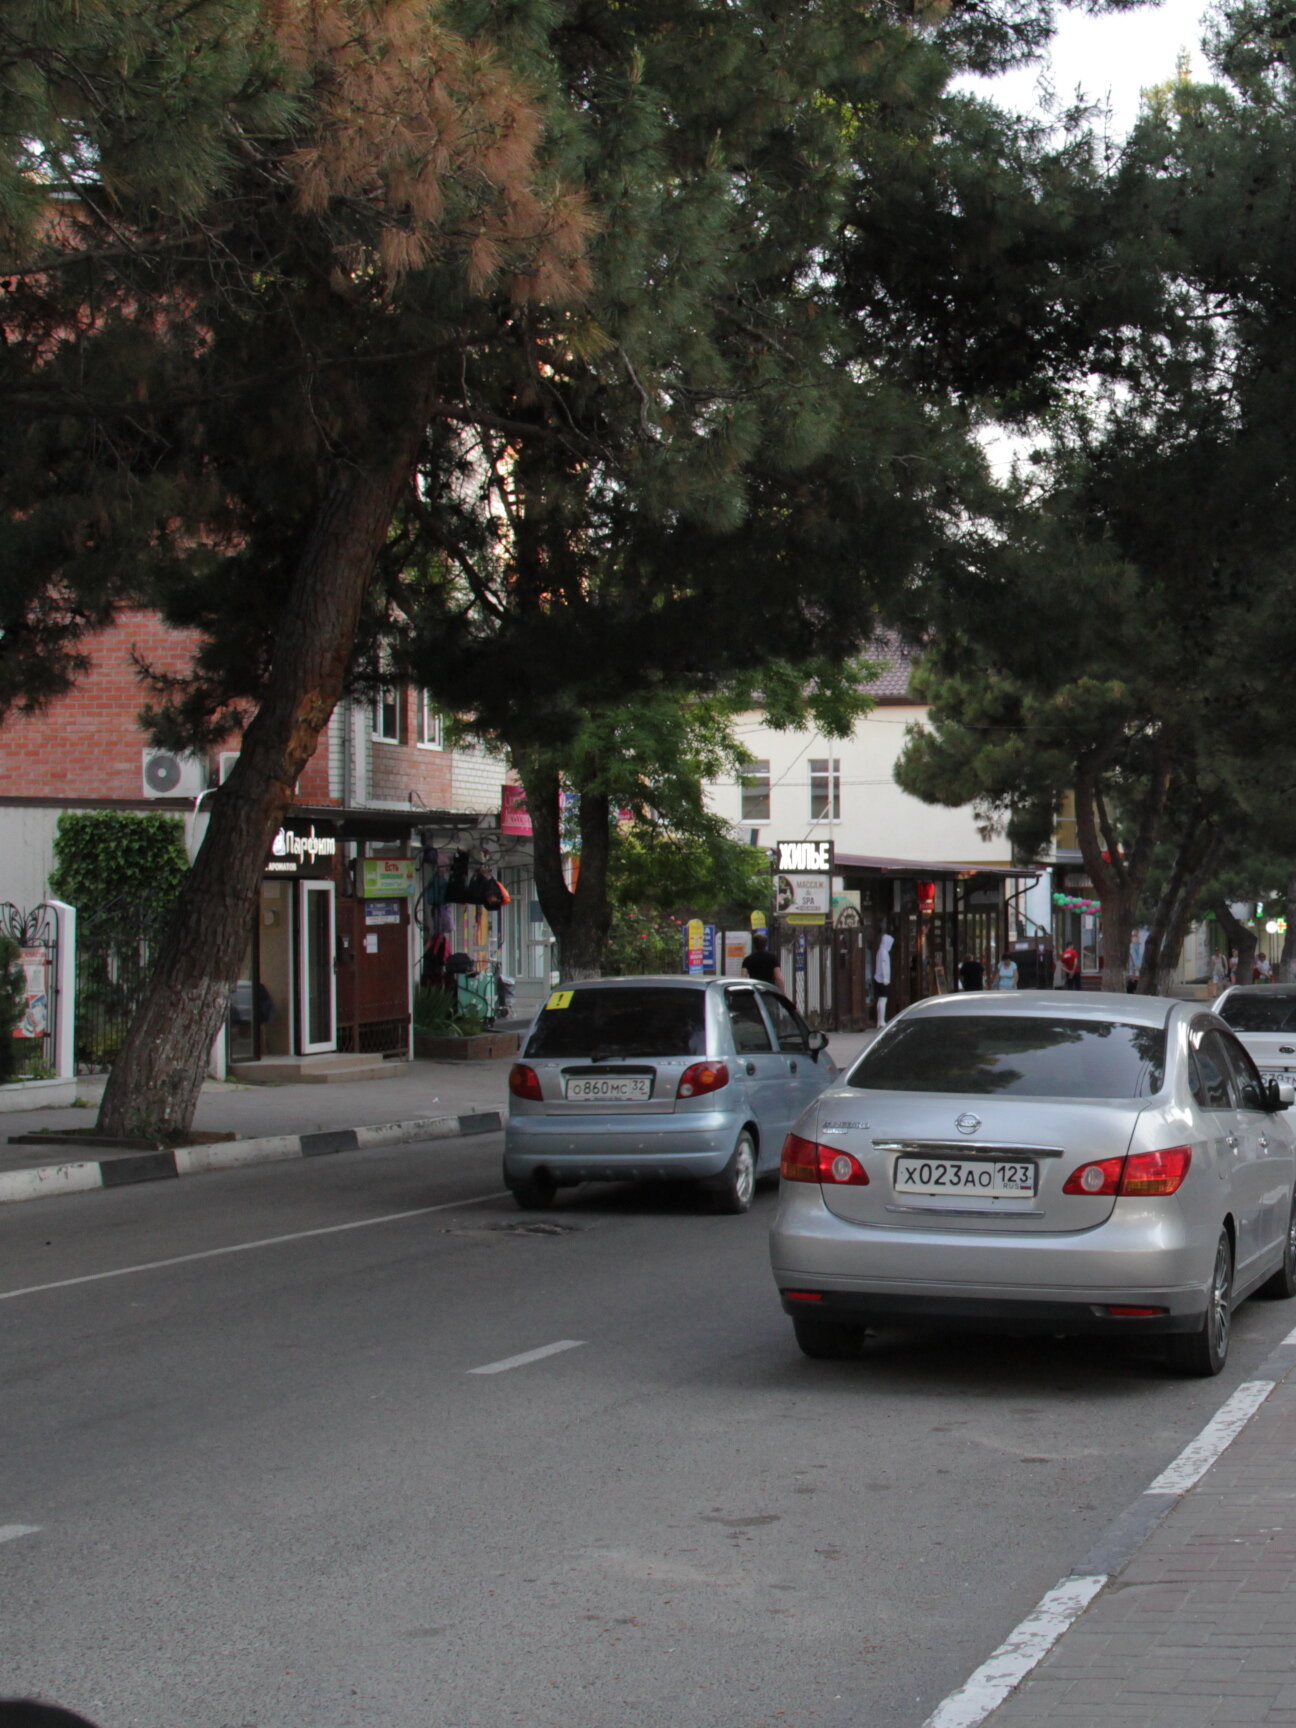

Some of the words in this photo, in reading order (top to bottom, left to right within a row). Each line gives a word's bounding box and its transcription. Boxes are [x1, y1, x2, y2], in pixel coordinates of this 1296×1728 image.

[779, 842, 829, 870] ЖИЛЬЕ
[802, 897, 815, 905] SPA
[997, 1165, 1030, 1183] 123
